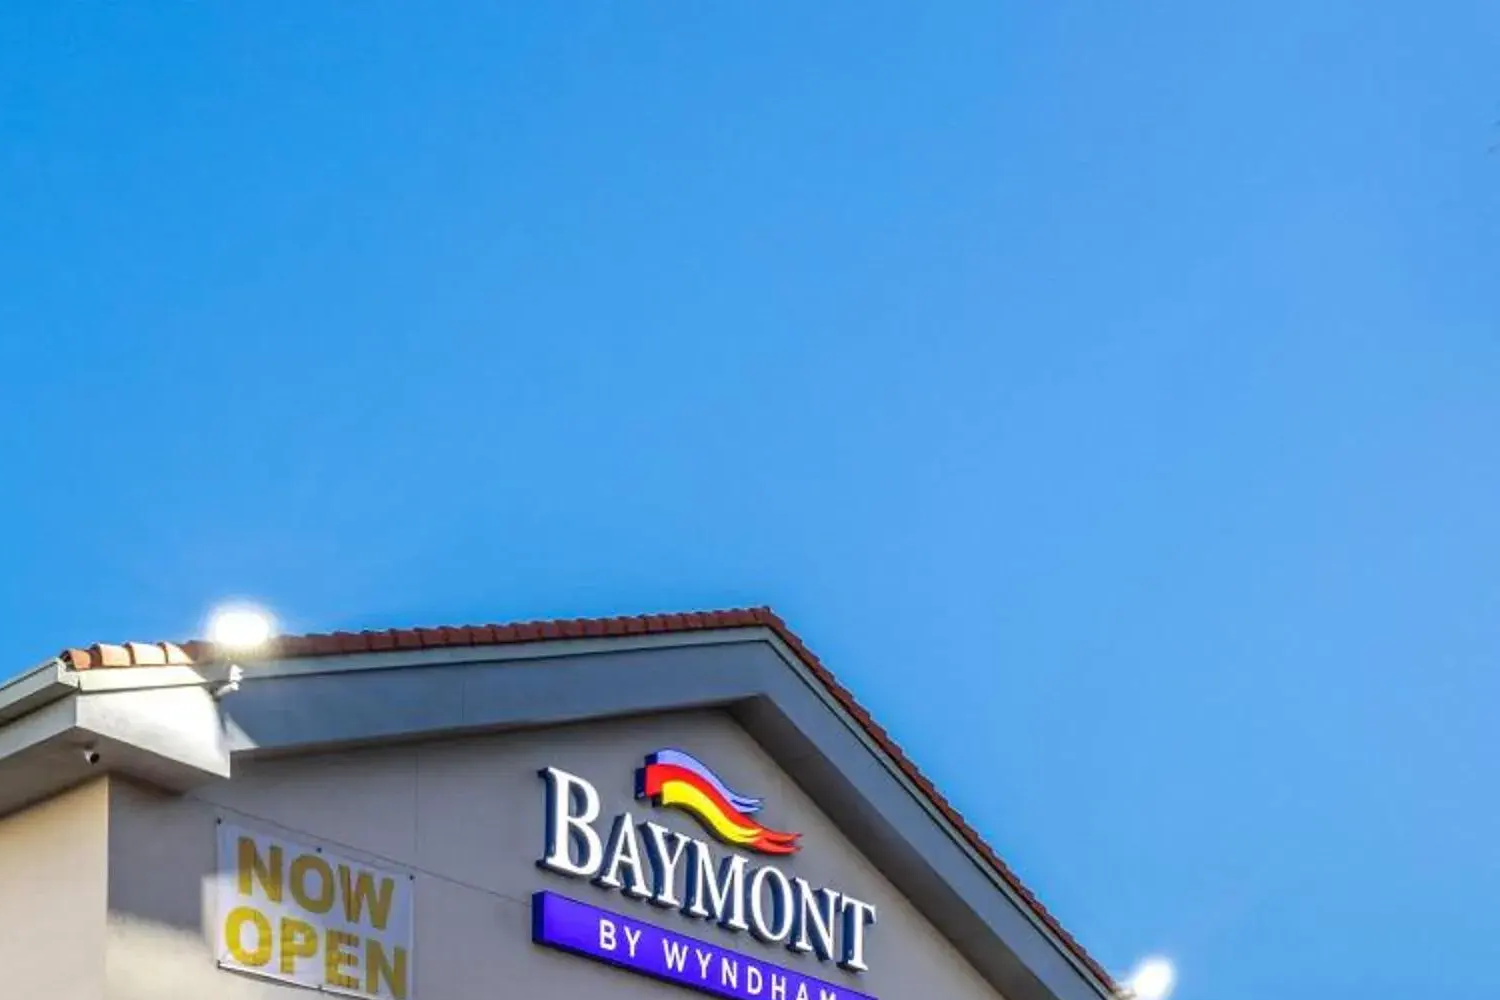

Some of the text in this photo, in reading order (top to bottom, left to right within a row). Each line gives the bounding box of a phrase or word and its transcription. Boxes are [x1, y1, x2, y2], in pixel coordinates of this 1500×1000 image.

[237, 836, 394, 930] NOW
[538, 766, 877, 972] BAYMONT
[224, 906, 408, 1000] OPEN
[599, 919, 642, 956] BY
